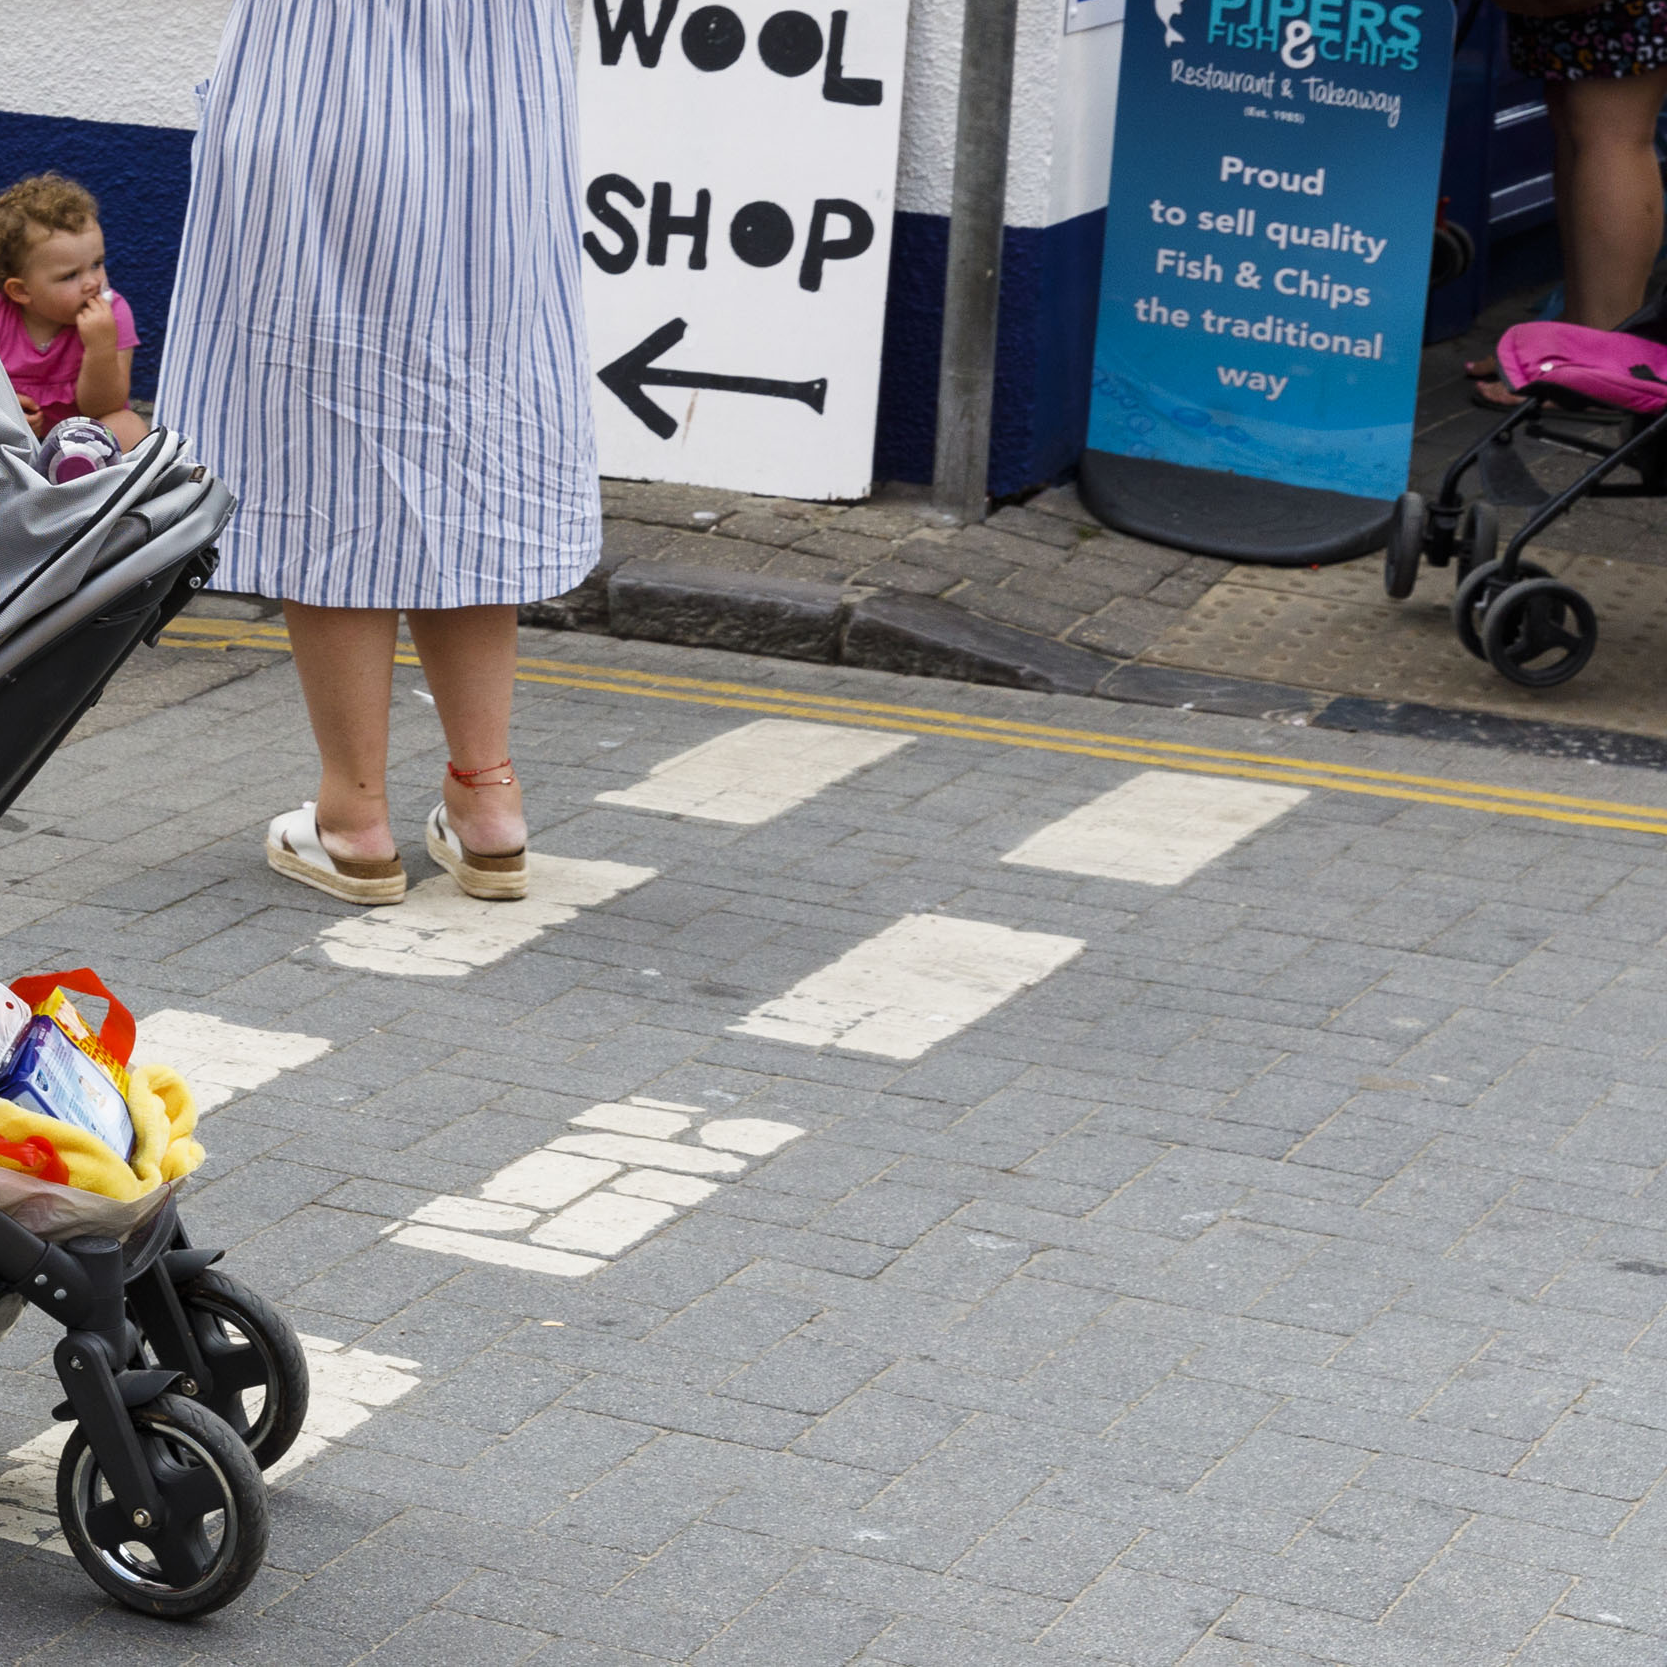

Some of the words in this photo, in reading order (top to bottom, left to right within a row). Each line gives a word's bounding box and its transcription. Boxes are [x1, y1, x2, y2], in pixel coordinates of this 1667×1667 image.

[1207, 21, 1279, 53] FISH
[1280, 19, 1316, 70] &
[1319, 33, 1419, 71] CHIPS
[1170, 58, 1276, 100] Restaurant
[1280, 77, 1295, 100] &
[1301, 76, 1402, 129] Takeaway
[1219, 154, 1326, 197] Proud
[582, 172, 875, 293] SHOP
[1149, 198, 1187, 227] to
[1197, 207, 1256, 238] sell
[1265, 220, 1389, 265] quality
[1155, 247, 1224, 284] Fish
[1234, 260, 1262, 291] &
[1273, 267, 1372, 311] Chips
[1134, 296, 1191, 329] the
[1201, 308, 1384, 361] traditional
[1216, 364, 1290, 402] way
